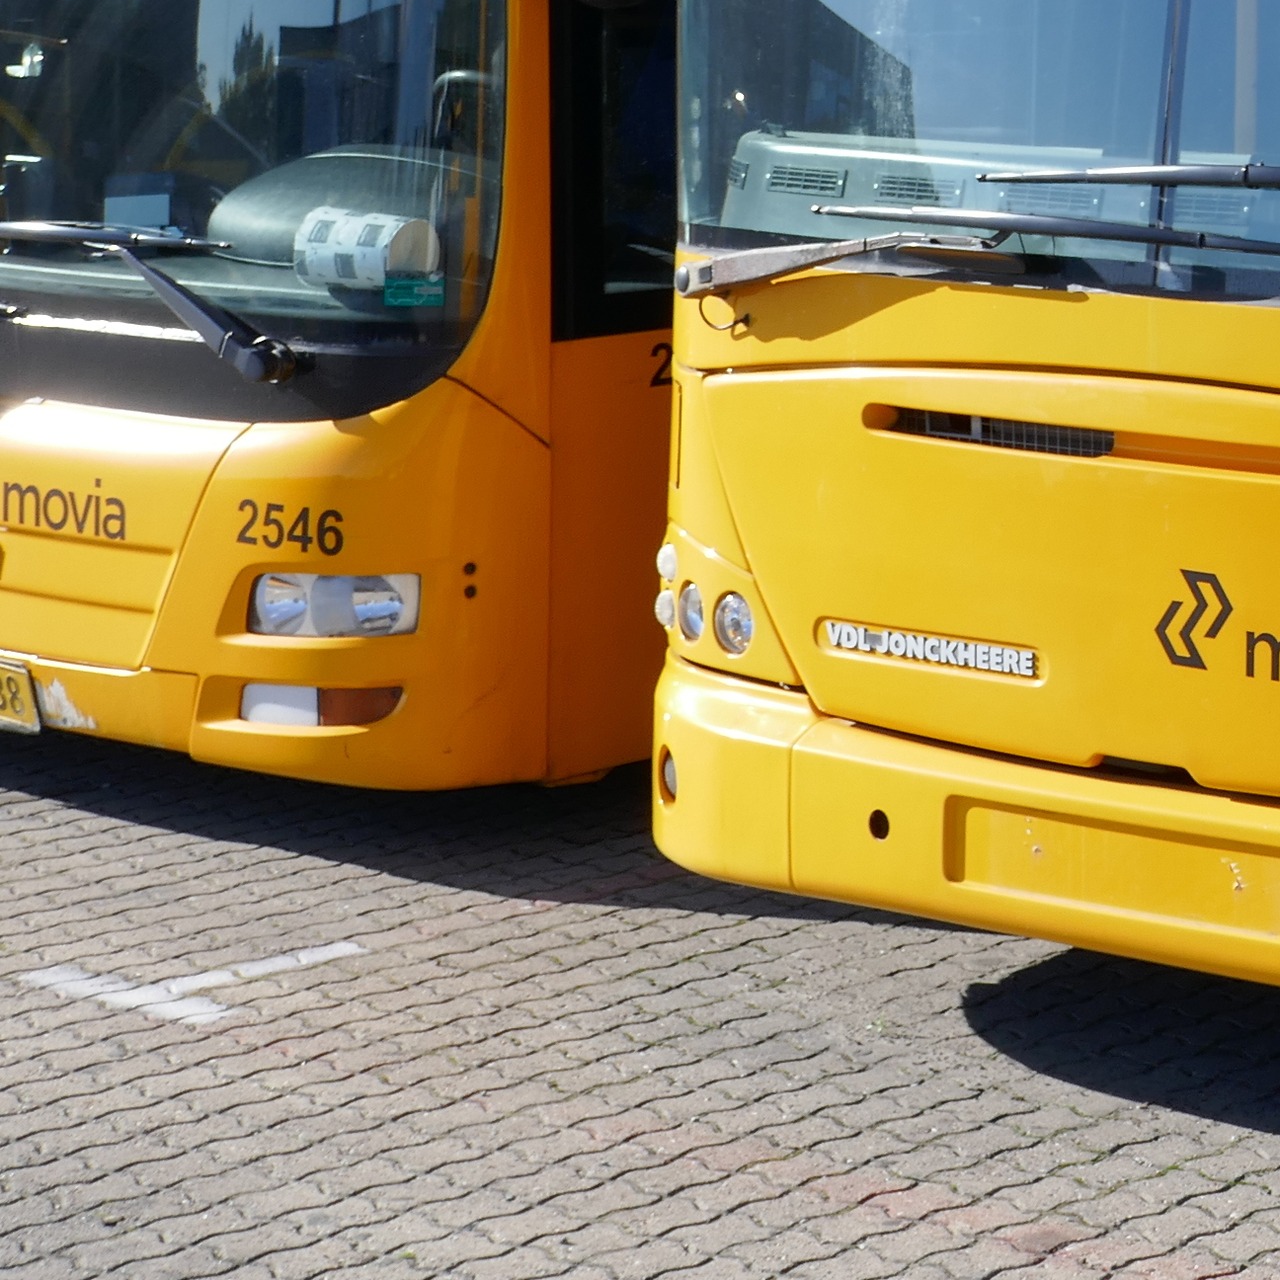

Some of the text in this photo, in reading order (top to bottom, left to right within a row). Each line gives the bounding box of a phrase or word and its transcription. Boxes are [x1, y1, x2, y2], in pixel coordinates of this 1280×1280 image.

[2, 478, 126, 541] movia
[236, 499, 344, 556] 2546
[825, 621, 1034, 676] VDL JONCKHEERE
